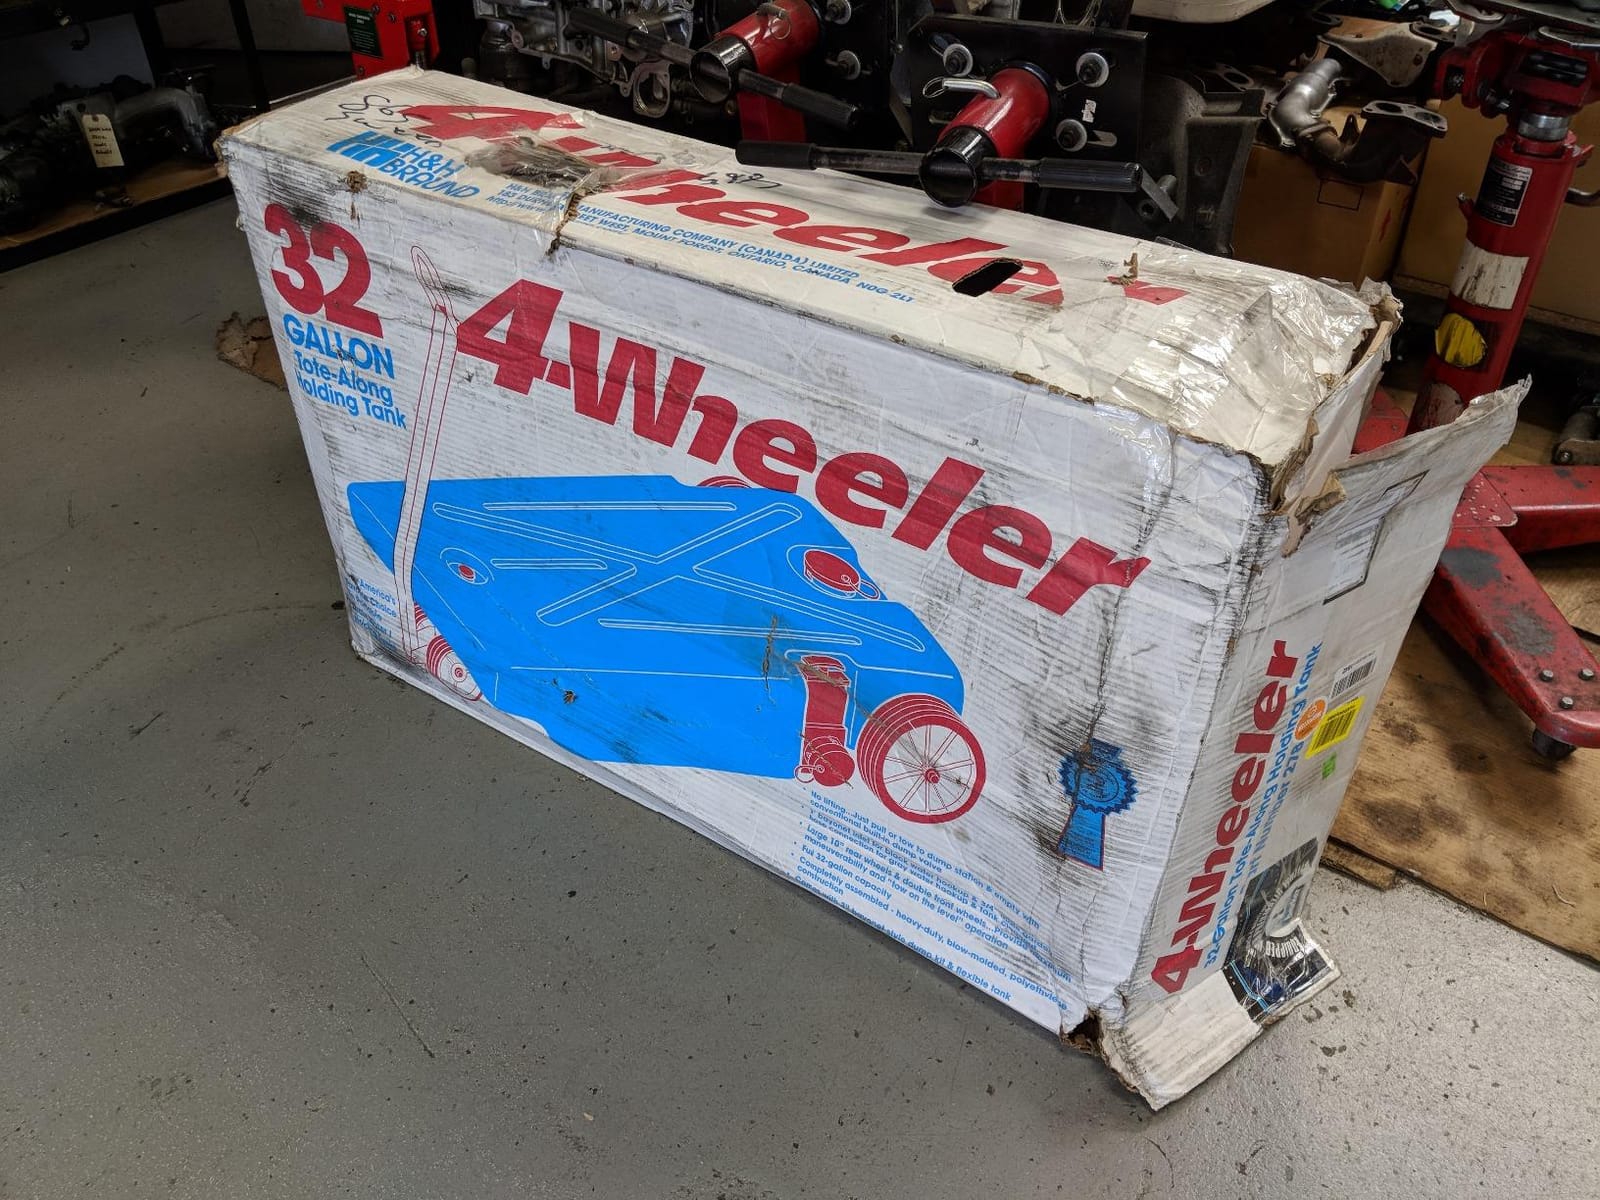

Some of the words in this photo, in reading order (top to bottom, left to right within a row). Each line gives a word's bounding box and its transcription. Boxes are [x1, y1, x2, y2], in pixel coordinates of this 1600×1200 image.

[378, 158, 481, 199] BRAUND
[399, 147, 466, 179] H&H
[263, 203, 384, 339] 32
[632, 228, 678, 244] MOUNT
[792, 264, 850, 285] CANADA
[674, 228, 738, 250] COMPANY
[738, 243, 808, 266] (CANADA)
[810, 260, 860, 279] LIMITED
[283, 313, 396, 380] GALLON
[294, 350, 394, 407] Tote-Along
[294, 366, 359, 416] Holding
[361, 396, 407, 430] Tank
[457, 278, 1151, 616] 4-Wheeler
[1282, 740, 1305, 778] 278
[809, 799, 862, 829] conventional
[863, 824, 890, 844] built-in
[892, 842, 916, 859] dump
[918, 857, 942, 873] valve
[1151, 639, 1299, 994] 4-Wheeler
[1203, 884, 1239, 970] 32-Gallon
[1228, 783, 1279, 886] Tote-Along
[1266, 698, 1307, 784] Holding
[1293, 641, 1324, 698] Tank
[796, 864, 845, 896] construction
[801, 844, 815, 857] Full
[815, 852, 854, 879] 32-gallon
[854, 874, 893, 900] capacity
[806, 824, 829, 842] Large
[845, 847, 863, 860] rear
[863, 856, 892, 877] wheels
[893, 872, 901, 881] &
[902, 878, 933, 898] double
[933, 893, 955, 910] front
[811, 790, 822, 800] No
[871, 821, 887, 833] pull
[888, 831, 897, 840] or
[899, 836, 914, 849] tow
[916, 845, 925, 855] to
[927, 852, 952, 870] dump
[954, 867, 984, 888] station
[986, 884, 993, 893] &
[994, 891, 1020, 915] empty
[1021, 912, 1040, 930] with
[817, 812, 851, 834] bayonet
[884, 848, 908, 865] black
[936, 876, 969, 899] hookup
[828, 826, 874, 854] connection
[888, 858, 909, 872] gray
[935, 882, 968, 905] hookup
[799, 855, 844, 886] Completely
[844, 882, 889, 911] assembled
[895, 908, 945, 944] heavy-duty,
[945, 936, 1008, 978] blow-molded,
[804, 834, 869, 873] maneuverability
[868, 869, 887, 884] and
[908, 891, 921, 902] on
[920, 896, 936, 911] the
[964, 922, 1009, 950] operation
[933, 954, 947, 966] kit
[946, 961, 955, 971] &
[955, 966, 989, 989] flexible
[989, 983, 1013, 1002] tank
